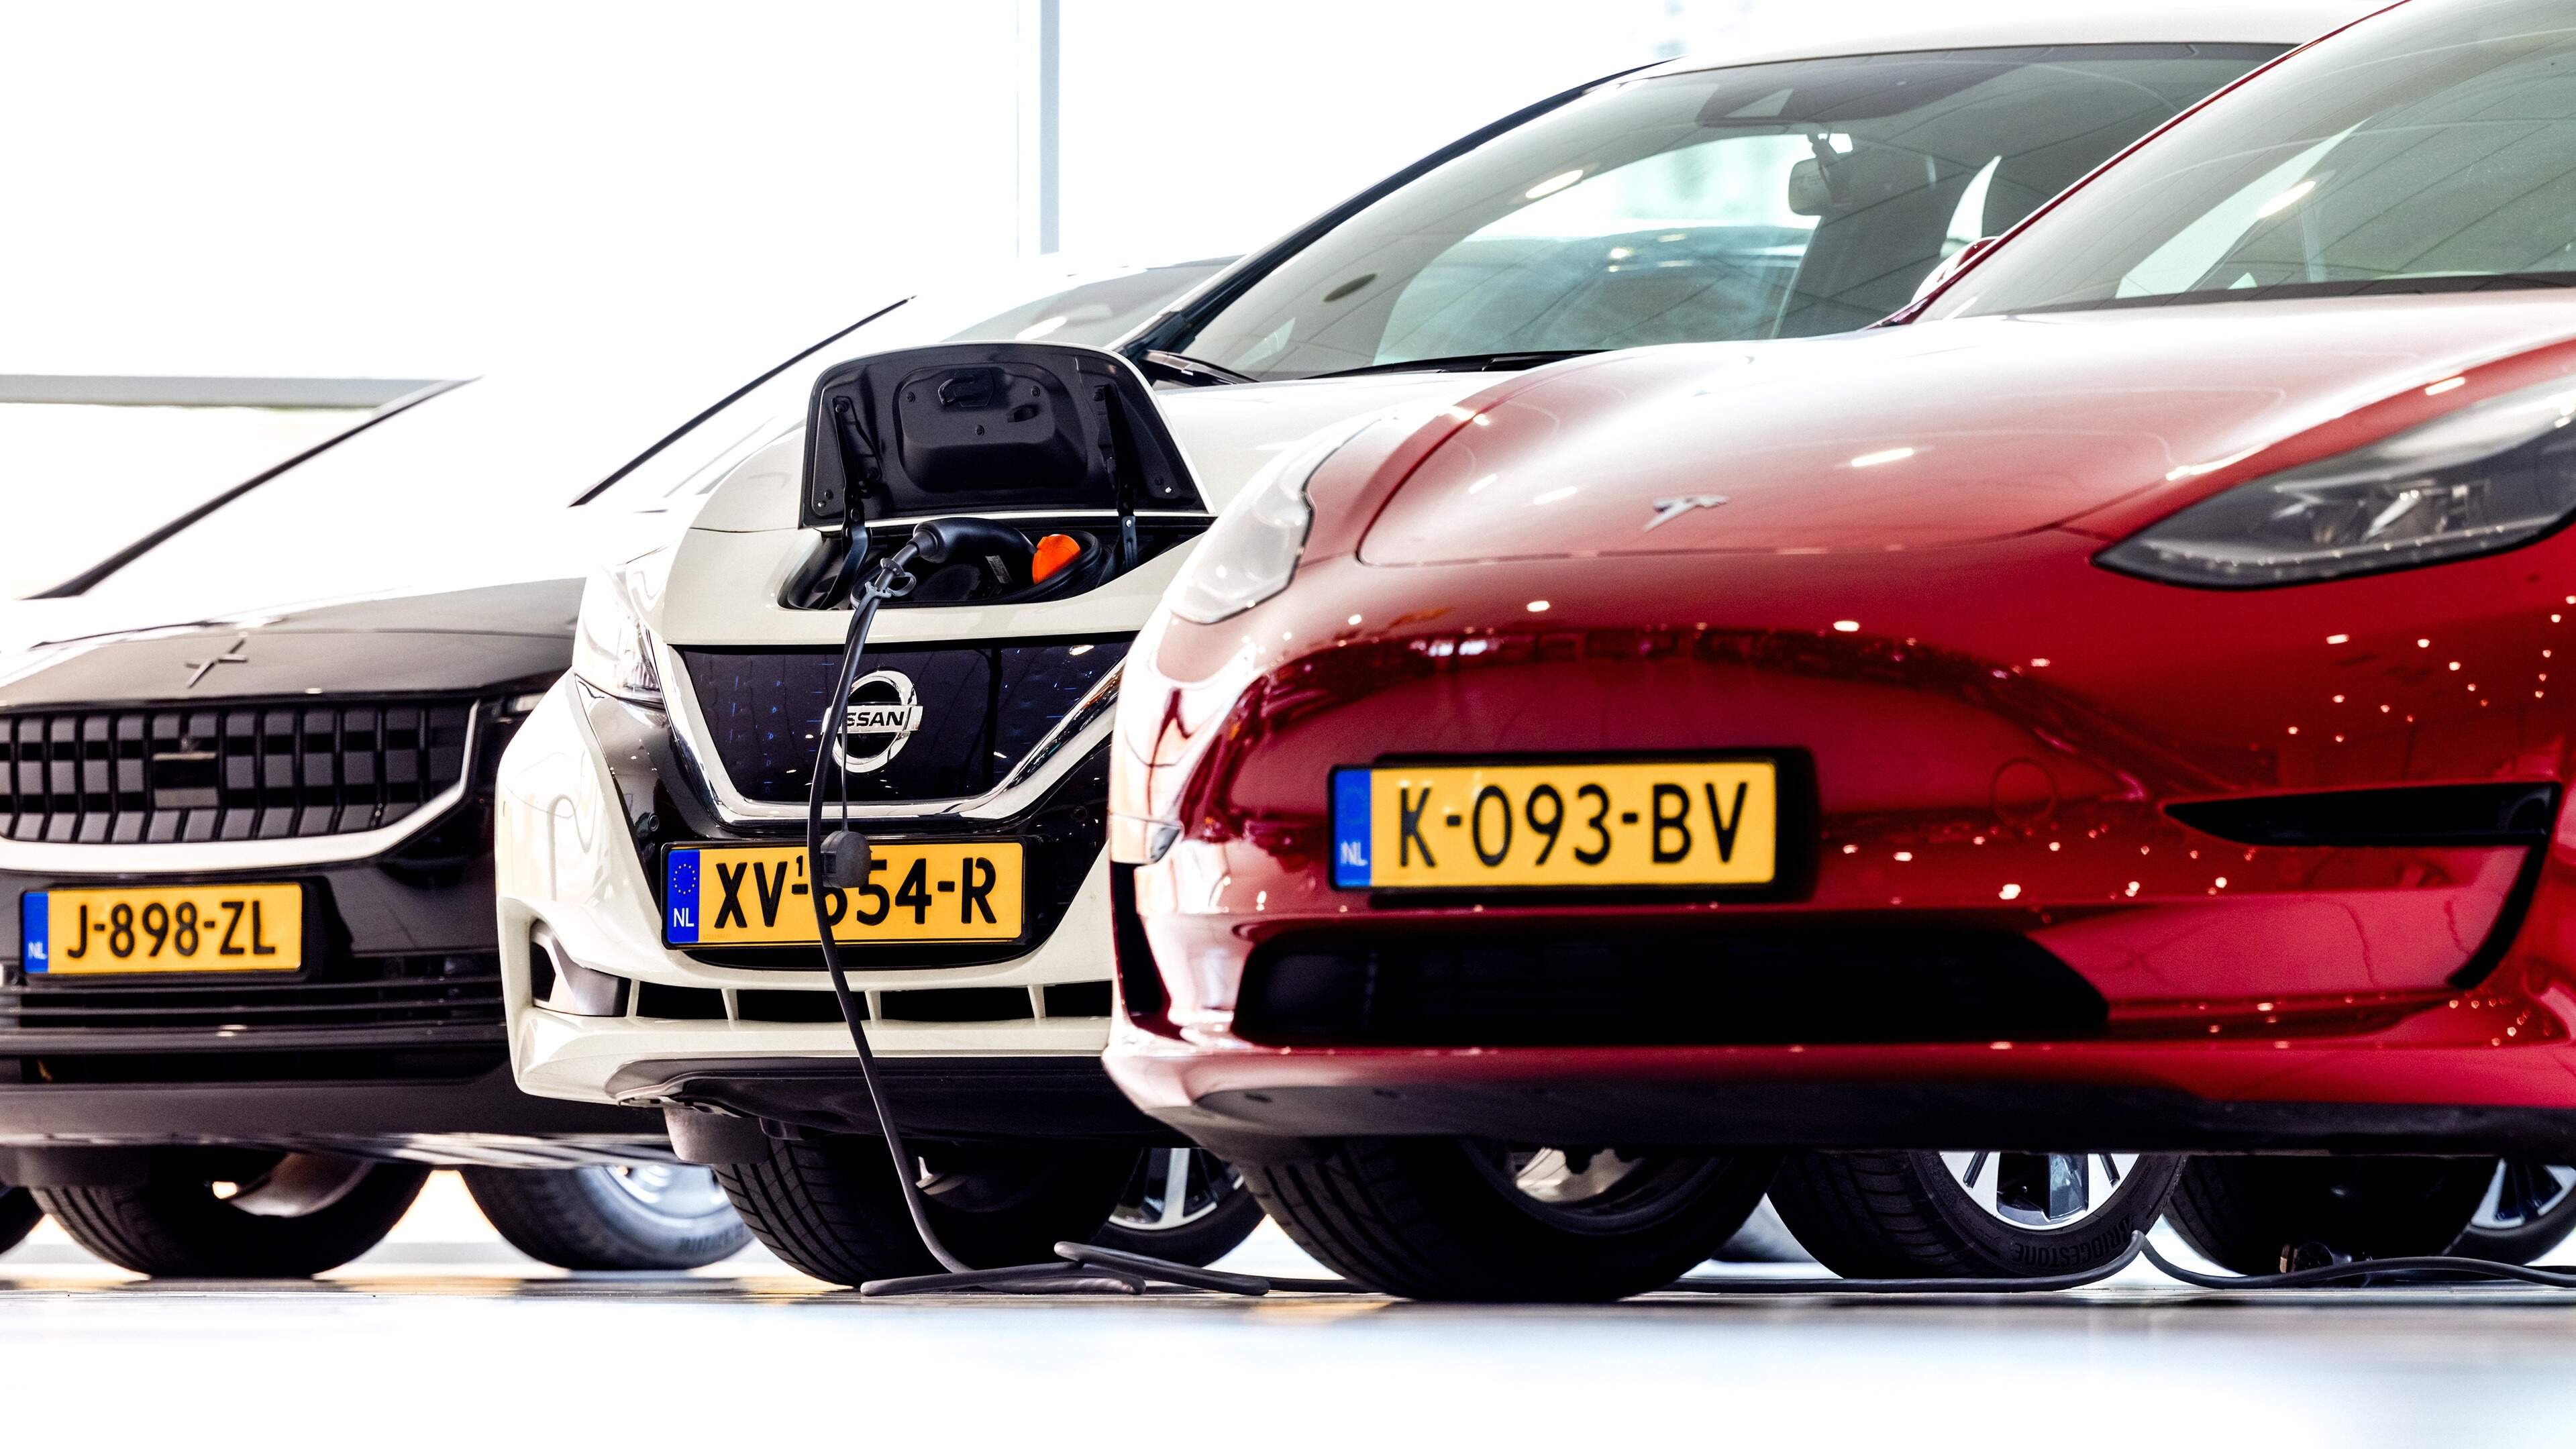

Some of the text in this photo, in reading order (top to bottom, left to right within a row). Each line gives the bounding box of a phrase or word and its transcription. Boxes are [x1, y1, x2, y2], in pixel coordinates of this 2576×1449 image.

[839, 711, 905, 727] SSAN
[1398, 782, 1747, 868] K-093-BV
[1340, 841, 1368, 867] NL
[68, 900, 276, 958] J-898-ZL
[673, 908, 694, 927] NL
[28, 942, 48, 959] NL
[2014, 1216, 2134, 1267] BRIDGESTONE
